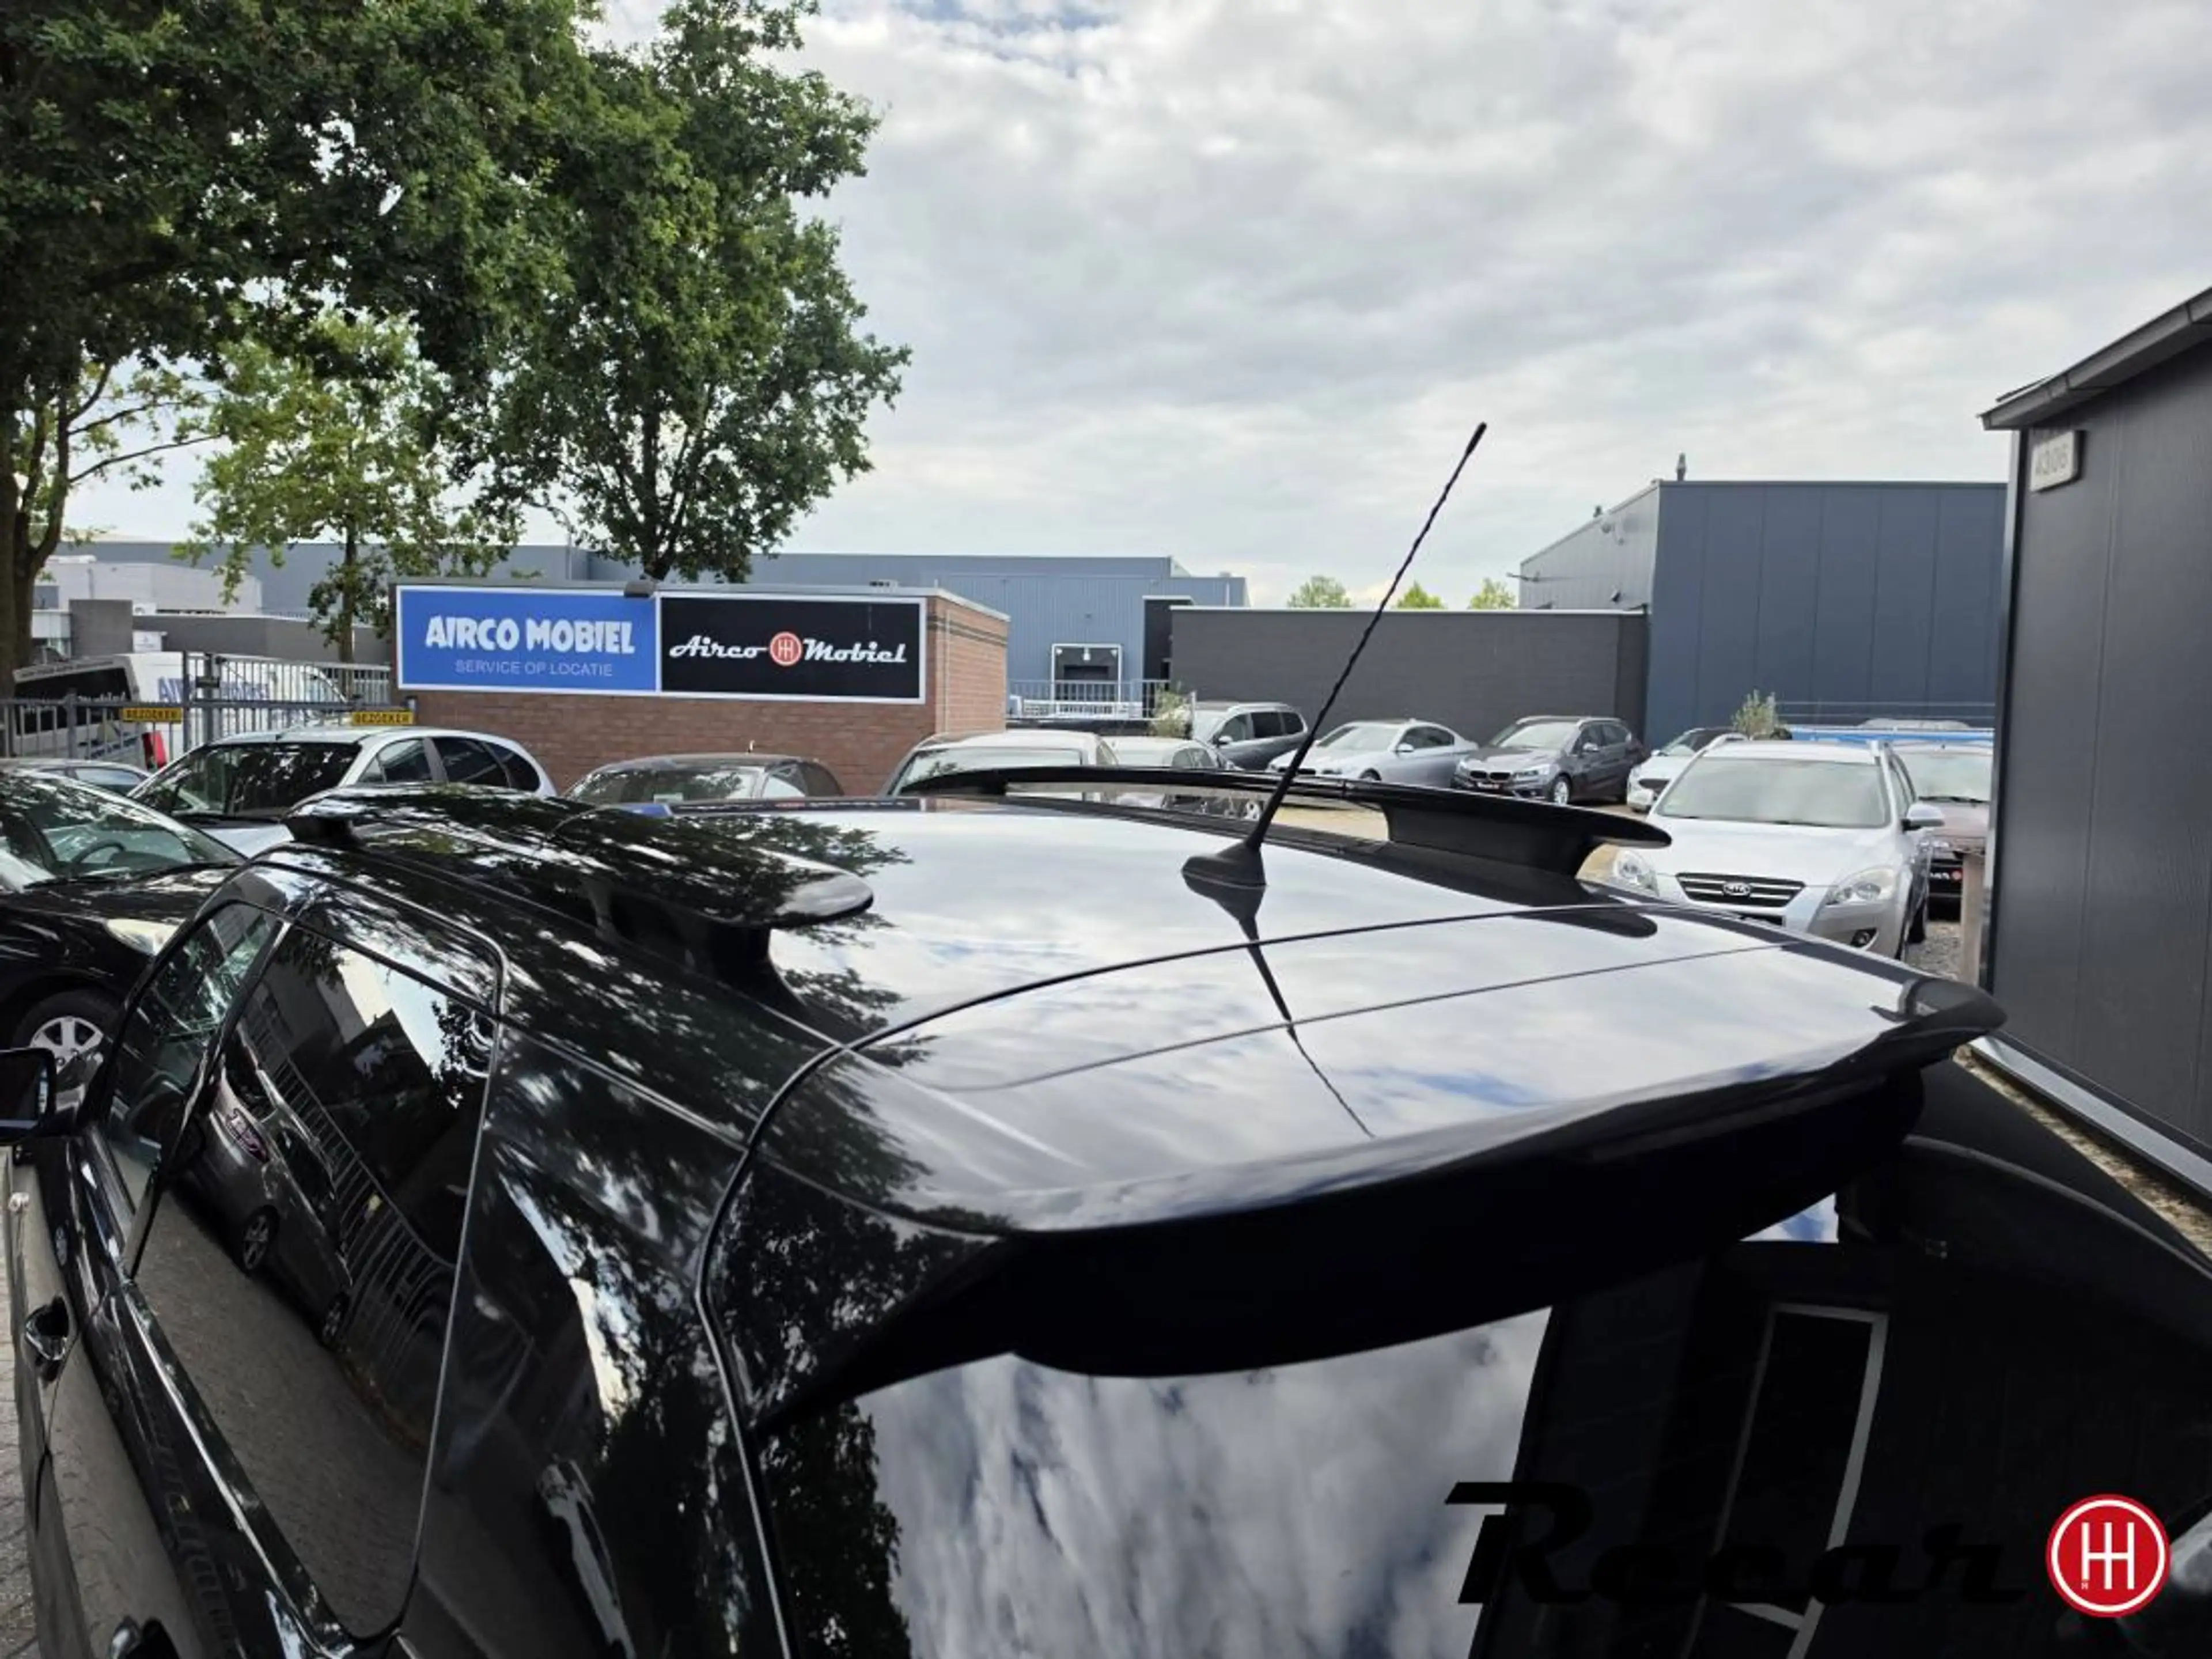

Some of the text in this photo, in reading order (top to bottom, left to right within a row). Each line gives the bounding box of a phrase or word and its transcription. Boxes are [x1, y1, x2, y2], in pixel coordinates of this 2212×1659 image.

[425, 615, 636, 654] AIRCO MOBIEL
[669, 635, 907, 663] Airco Mobiel
[454, 659, 613, 677] SERVICE OP LOCATIE
